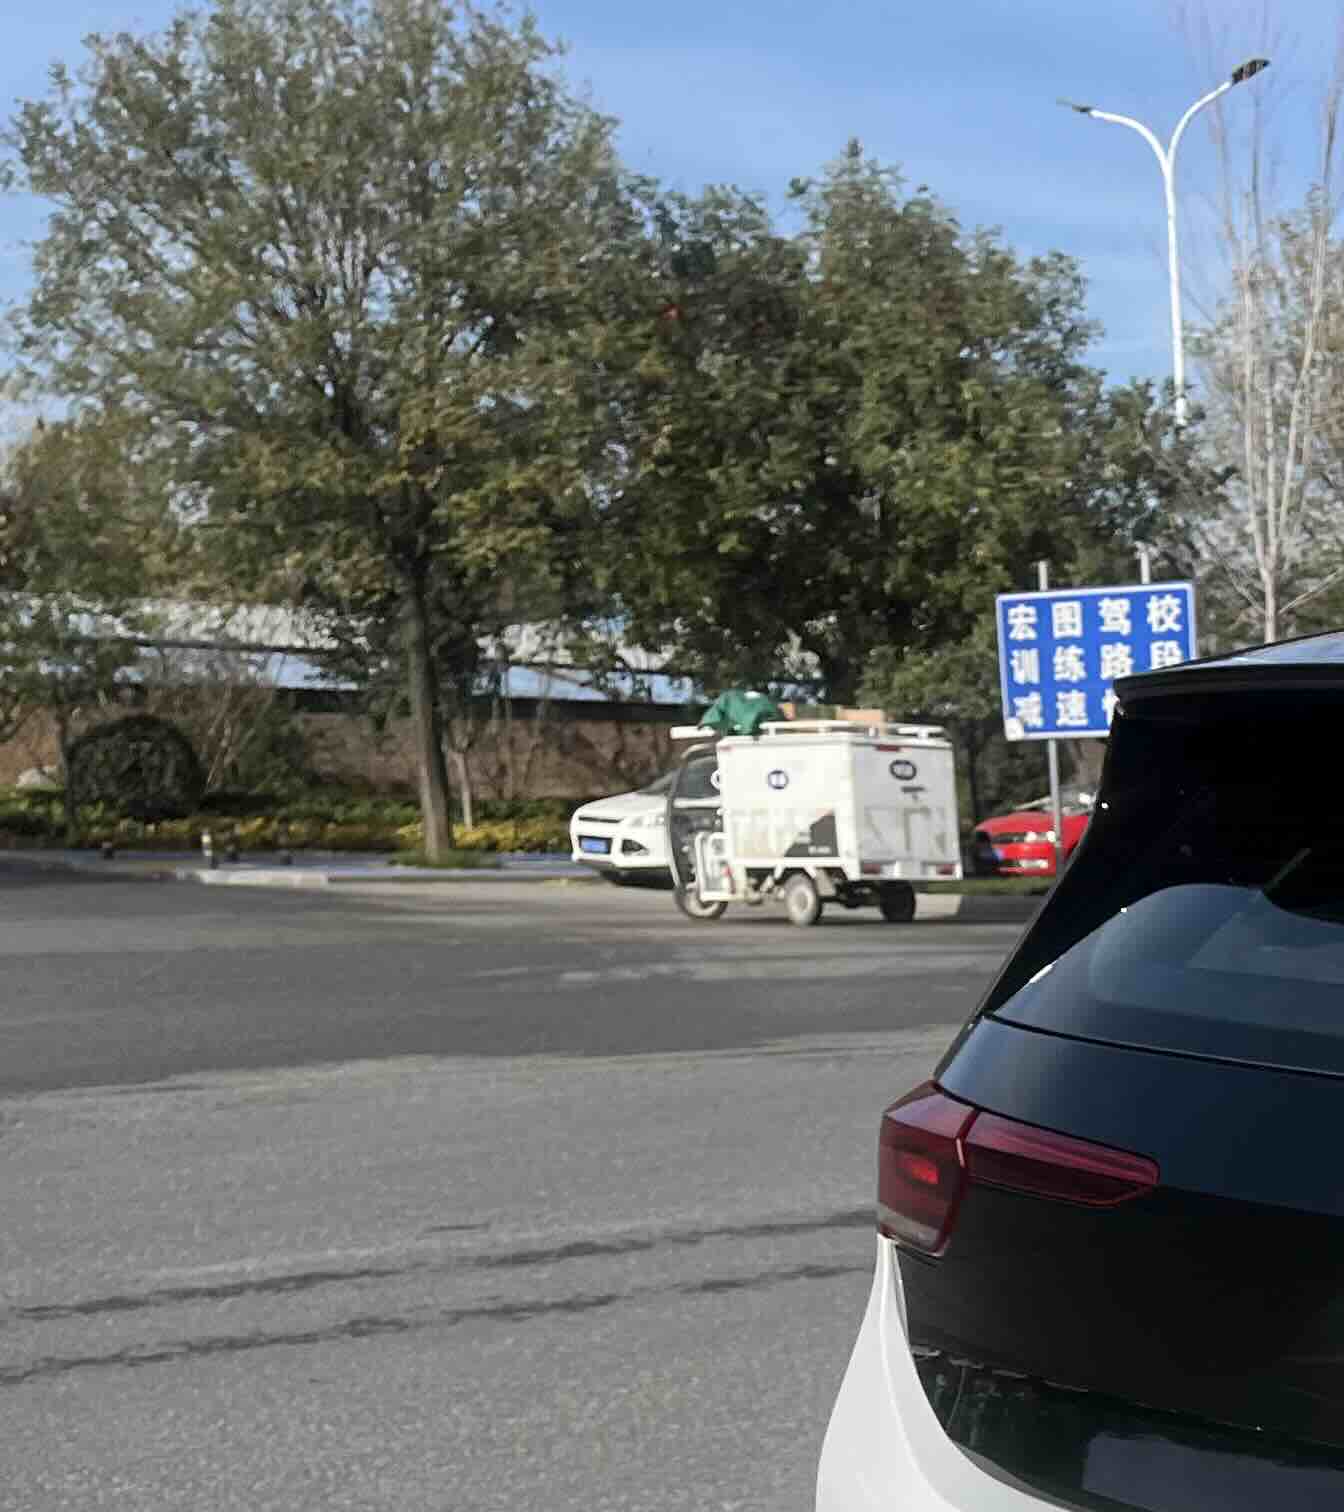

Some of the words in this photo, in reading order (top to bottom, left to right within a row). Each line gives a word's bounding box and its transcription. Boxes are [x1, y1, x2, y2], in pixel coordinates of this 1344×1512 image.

[1010, 640, 1184, 684] 训练路段
[1013, 689, 1120, 728] 减速
